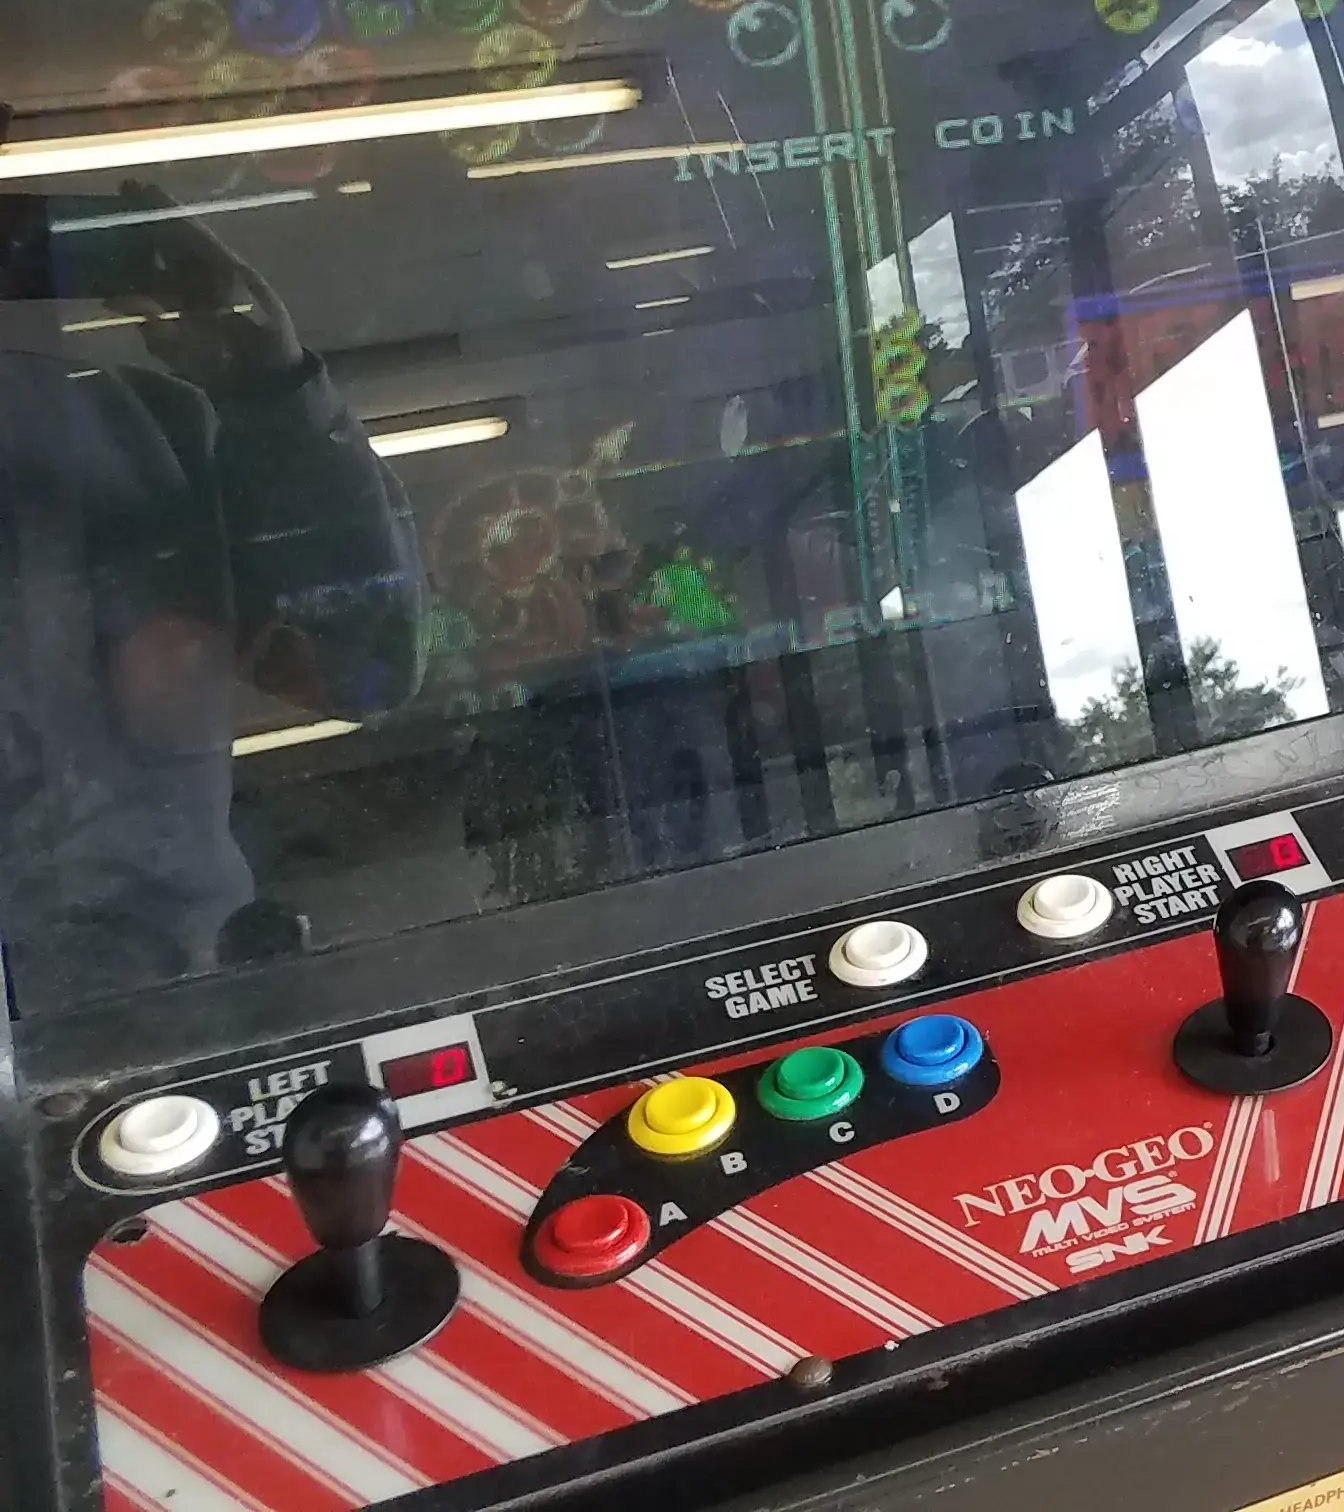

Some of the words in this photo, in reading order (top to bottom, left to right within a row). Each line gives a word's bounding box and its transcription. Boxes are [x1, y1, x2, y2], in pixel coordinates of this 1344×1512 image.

[672, 127, 896, 184] INSERT
[934, 108, 1076, 149] COIN
[1111, 845, 1199, 885] RIGHT
[1269, 834, 1303, 869] 0
[1112, 863, 1222, 908] PLAYER
[1133, 884, 1221, 925] START
[704, 954, 817, 999] SELECT
[725, 979, 819, 1019] GAME
[247, 1060, 332, 1102] LEFT
[432, 1048, 467, 1087] 0
[933, 1091, 962, 1114] D
[828, 1120, 856, 1144] C
[719, 1150, 748, 1175] B
[658, 1200, 689, 1228] A
[1019, 1174, 1197, 1254] MVS
[1030, 1238, 1078, 1258] MULTI
[1081, 1221, 1130, 1242] VIDEO
[1132, 1201, 1197, 1227] SYSTEM
[1064, 1224, 1174, 1275] SNK
